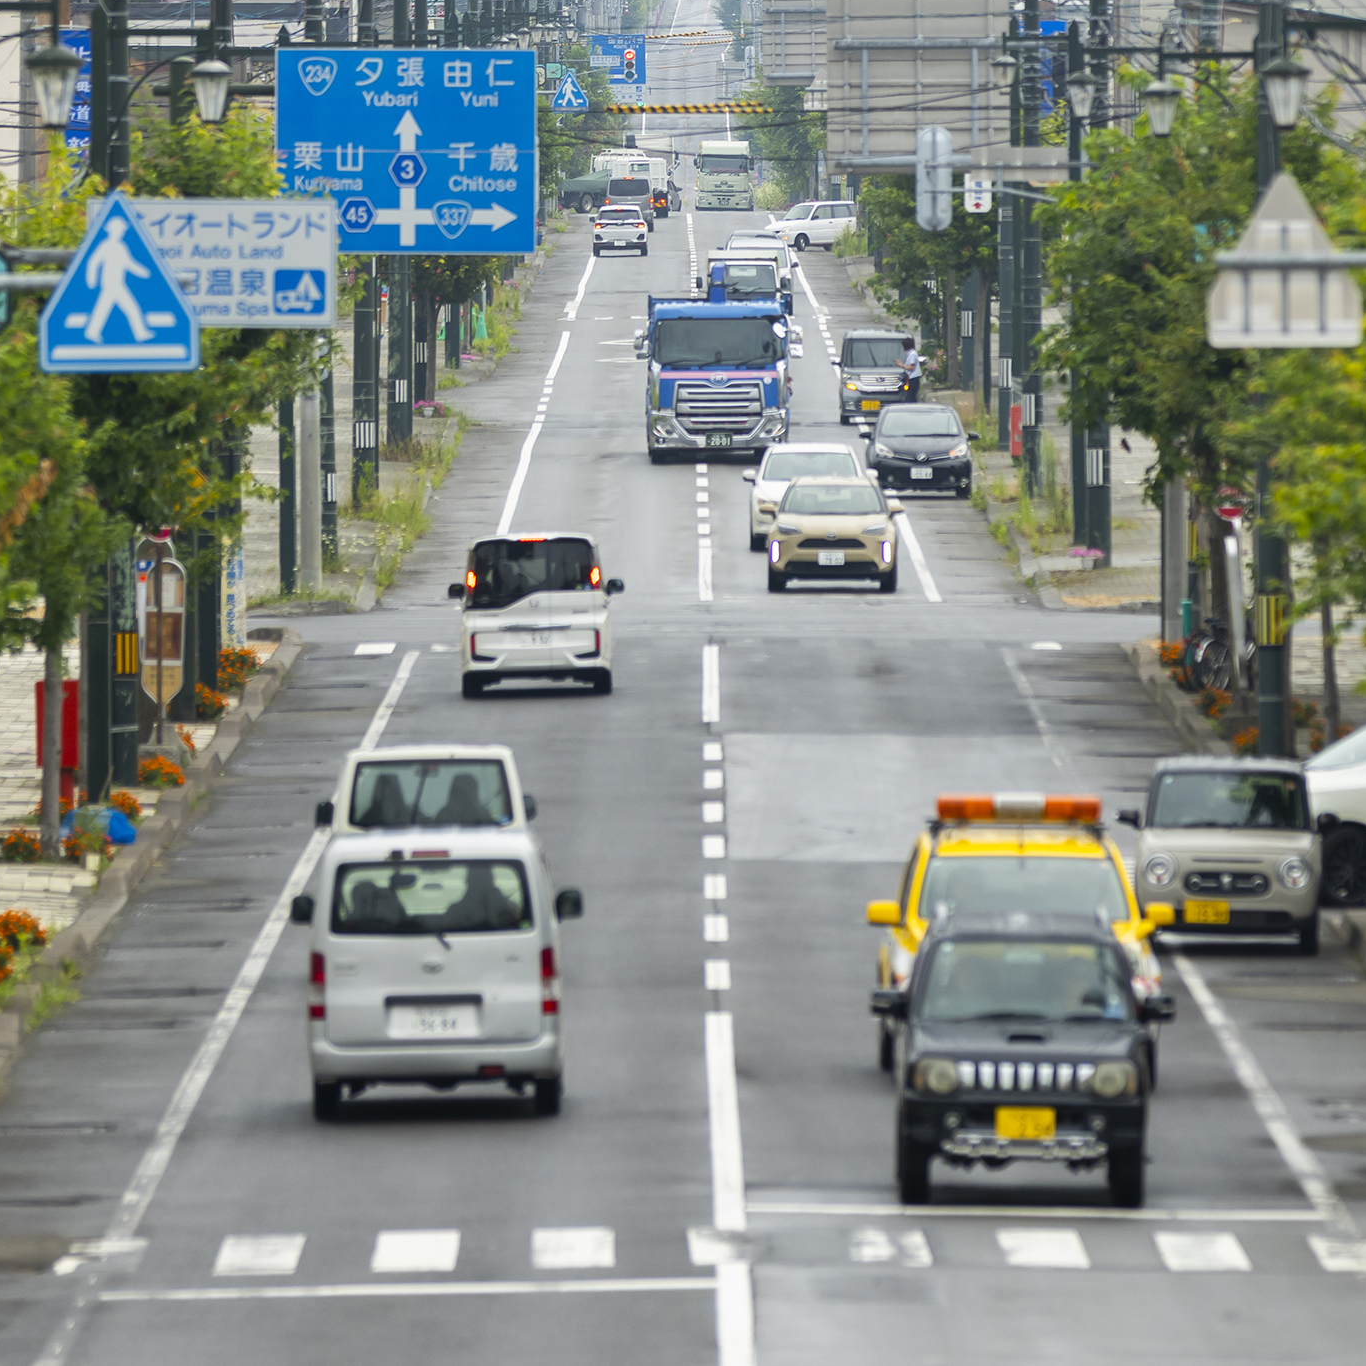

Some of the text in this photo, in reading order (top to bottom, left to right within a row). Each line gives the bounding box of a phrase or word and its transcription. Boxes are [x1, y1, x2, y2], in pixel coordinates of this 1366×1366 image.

[305, 65, 331, 83] 234
[355, 57, 515, 87] 夕張 由仁
[362, 90, 499, 107] Yubari Yuni
[294, 141, 518, 172] 栗山 千歳
[400, 160, 415, 180] 3
[294, 175, 517, 194] Kuriyama Chitose
[346, 207, 368, 223] 45
[440, 209, 467, 226] 337
[136, 211, 327, 239] イオートランド
[190, 243, 232, 260] Auto
[238, 243, 285, 260] Land
[235, 301, 270, 318] Spa
